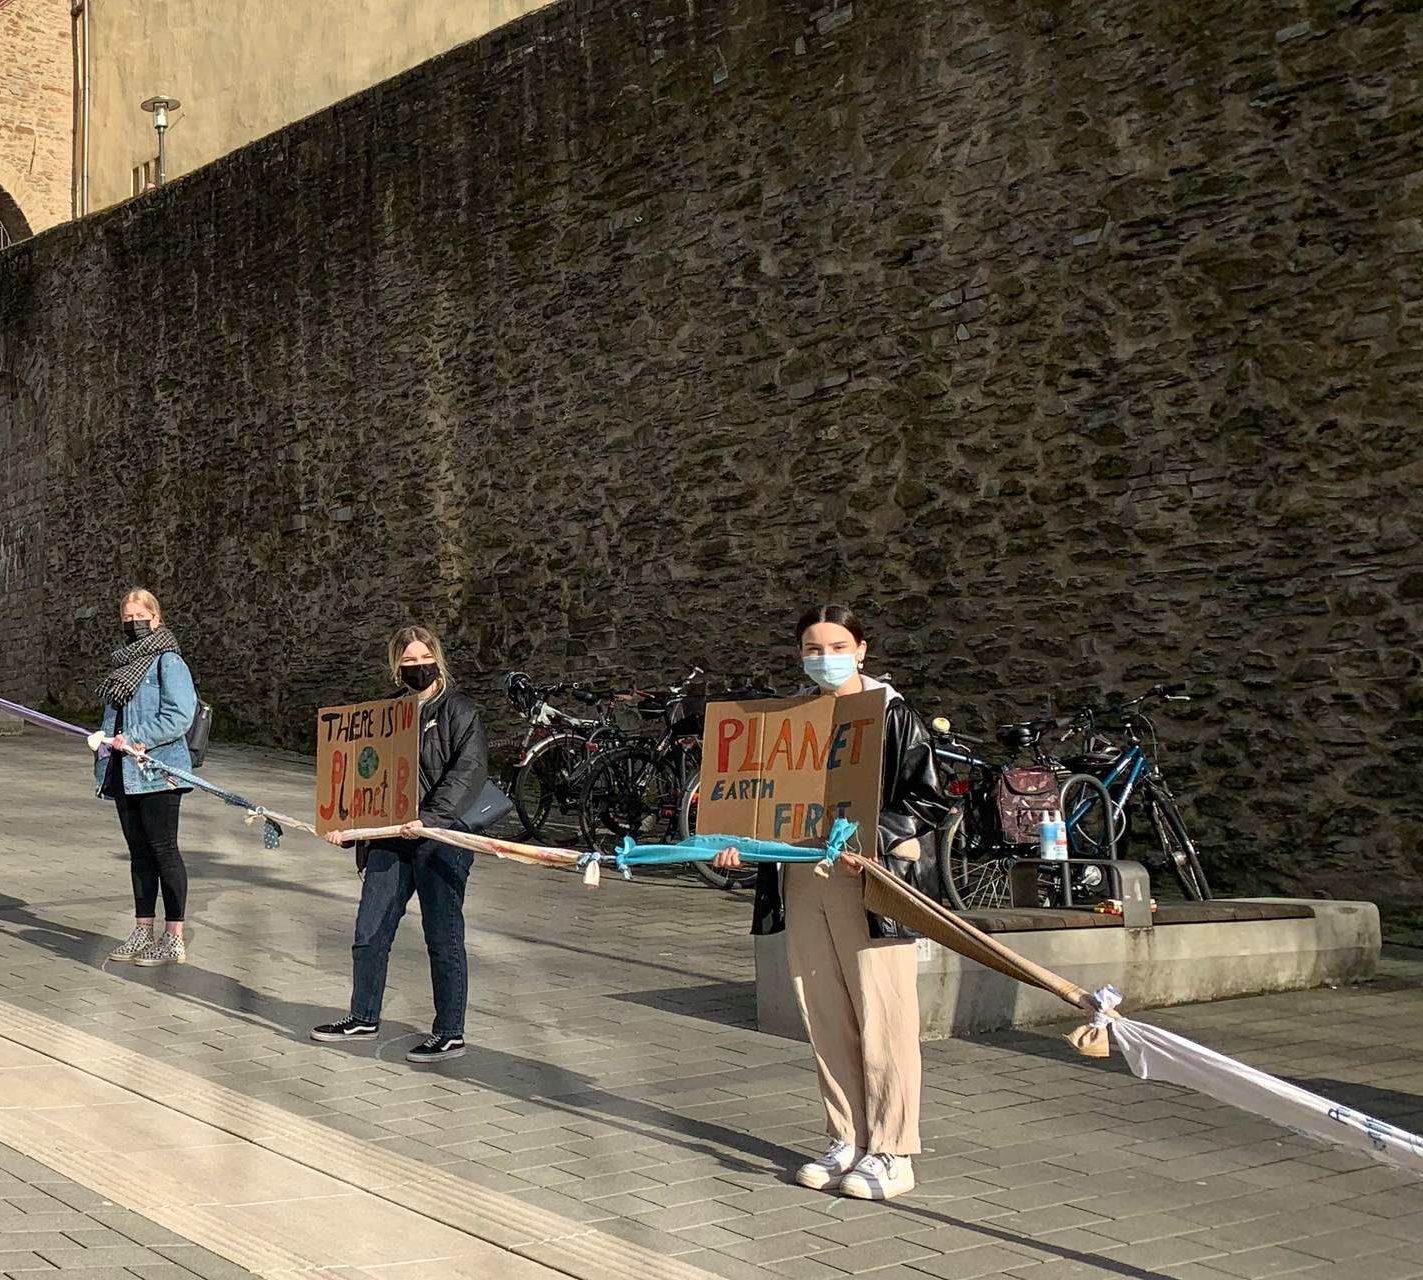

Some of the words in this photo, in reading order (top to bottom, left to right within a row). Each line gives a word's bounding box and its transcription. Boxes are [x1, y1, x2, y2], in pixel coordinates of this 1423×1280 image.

[321, 708, 375, 742] THERE
[380, 706, 394, 738] IS
[394, 700, 414, 734] NO
[716, 717, 875, 773] PLANET
[396, 756, 410, 820] B
[710, 778, 775, 802] EARTH
